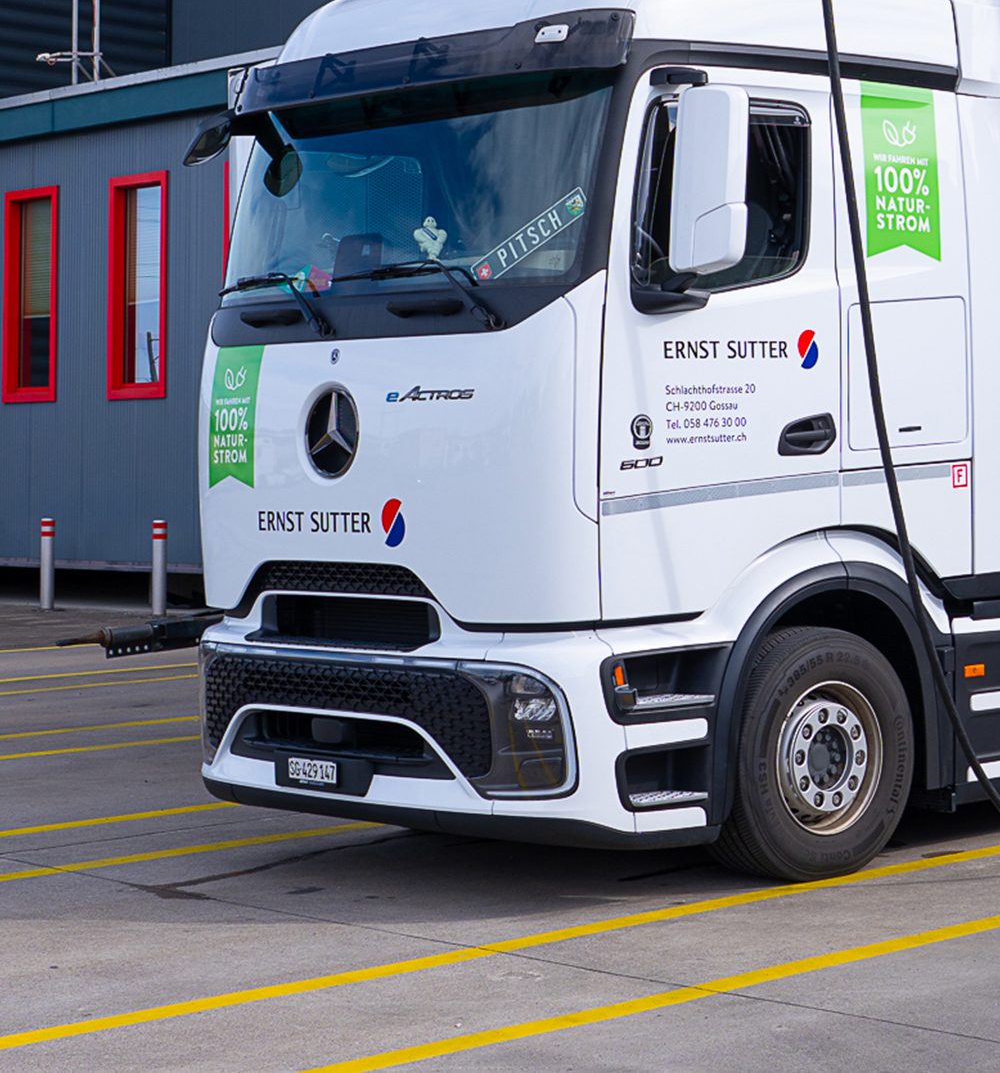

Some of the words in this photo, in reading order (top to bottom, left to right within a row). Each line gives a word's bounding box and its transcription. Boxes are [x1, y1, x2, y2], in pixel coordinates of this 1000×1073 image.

[873, 154, 887, 162] WIR
[888, 154, 916, 164] FAHREN
[917, 157, 929, 167] MIT
[874, 165, 930, 196] 100%
[876, 195, 931, 214] NATUR-
[876, 213, 931, 233] STROM
[497, 209, 563, 268] PITSCH
[663, 340, 720, 359] ERNST
[727, 340, 788, 359] SUTTER
[665, 384, 743, 395] Schlachthofstrasse
[745, 383, 756, 394] 20
[665, 401, 707, 412] CH-9200
[709, 400, 738, 411] Gossau
[214, 407, 248, 432] 100%
[666, 419, 681, 430] Tel.
[683, 418, 701, 429] 058
[703, 417, 720, 428] 476
[721, 417, 733, 428] 30
[734, 417, 747, 427] 00
[213, 433, 248, 448] NATUR-
[666, 432, 747, 444] www.ernstsutter.ch
[213, 449, 248, 464] STROM
[620, 456, 663, 471] 600
[258, 510, 305, 532] ERNST
[310, 511, 372, 533] SUTTER
[786, 654, 824, 687] 385/55
[825, 652, 834, 663] R
[889, 714, 908, 804] Continental
[320, 765, 335, 779] 147
[758, 761, 769, 795] HS3
